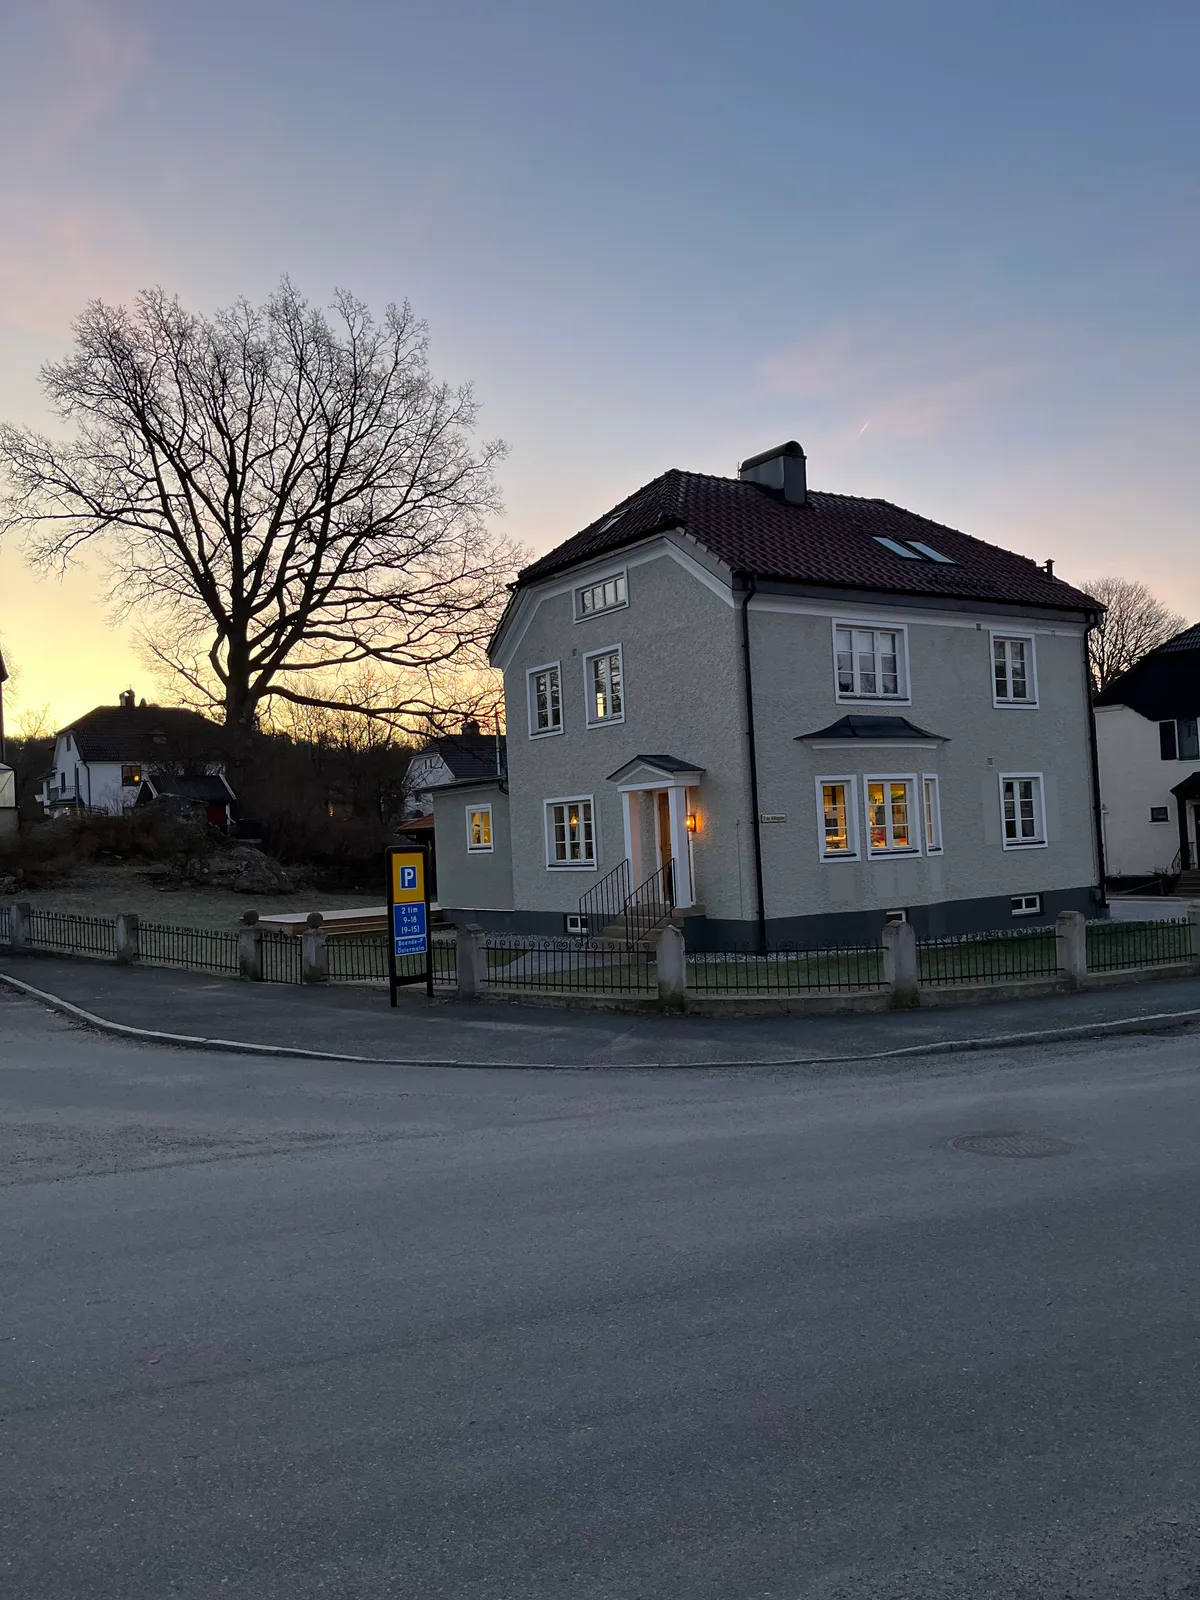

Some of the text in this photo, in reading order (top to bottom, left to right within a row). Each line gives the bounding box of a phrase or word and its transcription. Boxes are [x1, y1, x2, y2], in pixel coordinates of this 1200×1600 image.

[404, 868, 414, 887] P
[402, 916, 418, 924] 9-18
[401, 924, 420, 934] (9-15)
